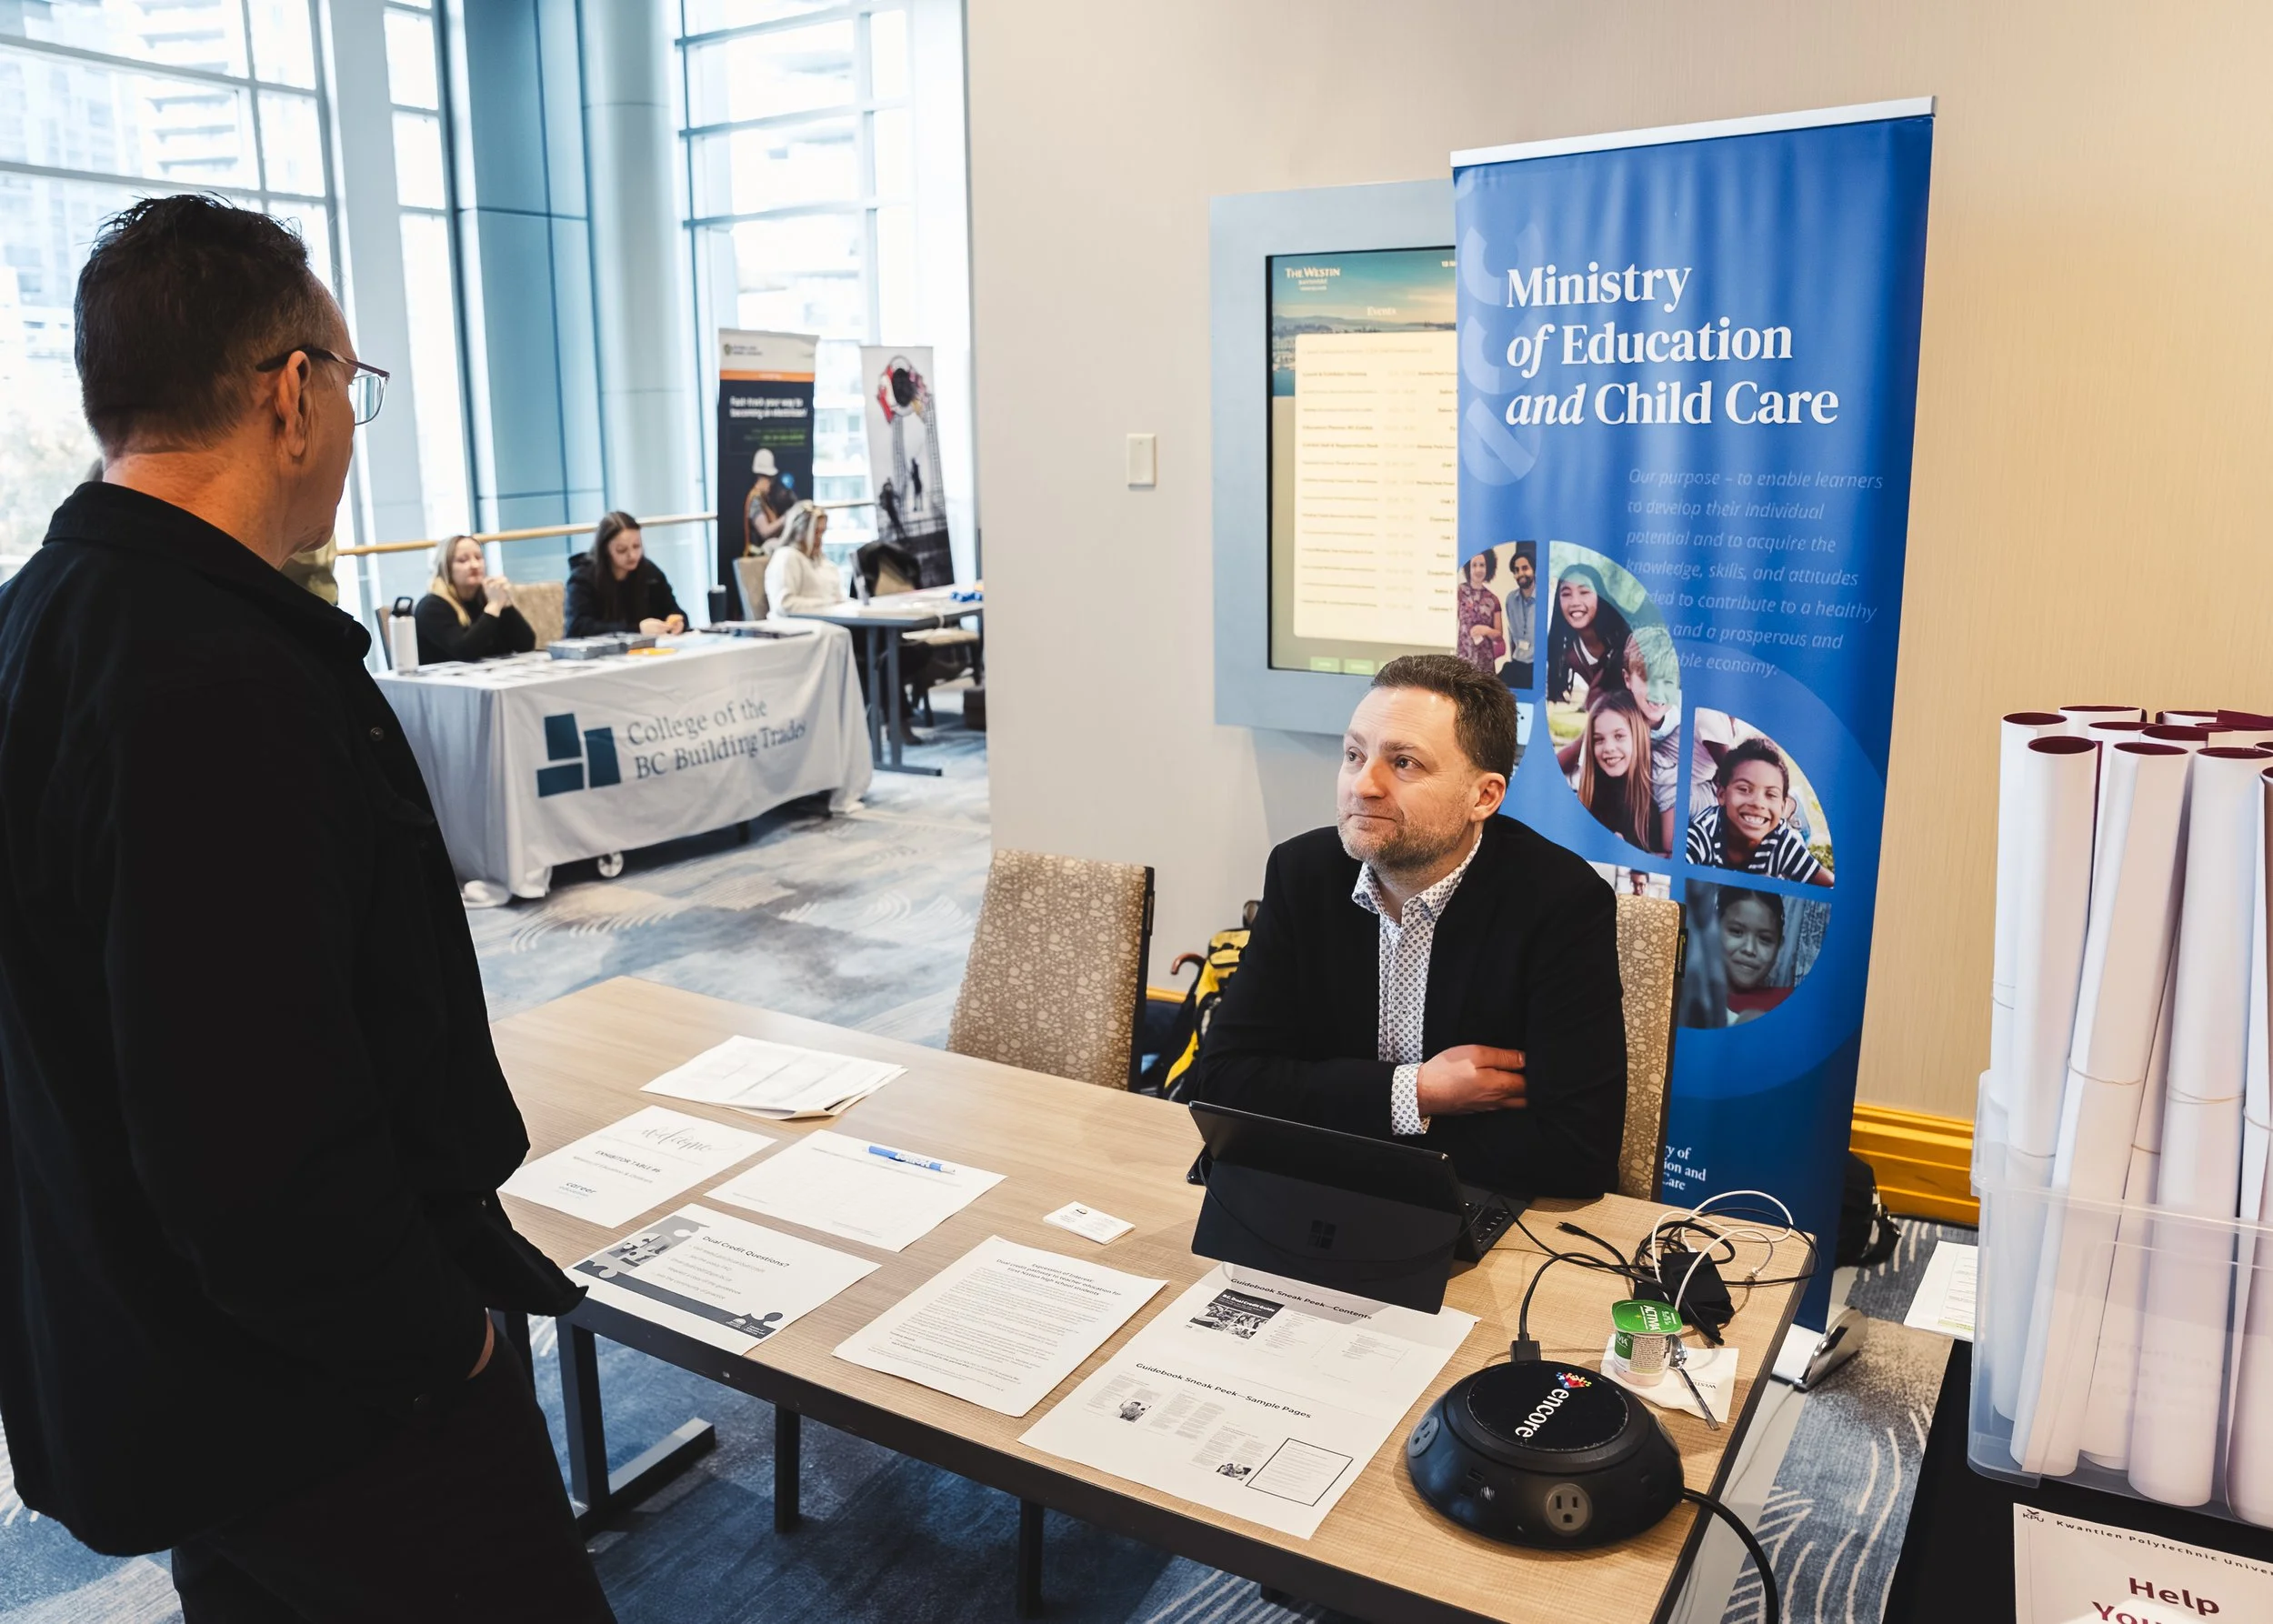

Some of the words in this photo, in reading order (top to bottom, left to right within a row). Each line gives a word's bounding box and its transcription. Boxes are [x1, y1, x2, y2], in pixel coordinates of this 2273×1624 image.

[1304, 266, 1341, 277] WESTIN
[1507, 262, 1691, 313] Ministry
[1507, 324, 1554, 378] of
[1562, 317, 1793, 365] Education
[1506, 384, 1587, 425] and
[1595, 381, 1712, 424] Child
[1725, 382, 1839, 424] Care
[1629, 468, 1657, 484] Our
[1657, 471, 1719, 488] purpose
[1737, 473, 1752, 486] to
[1757, 470, 1811, 487] enable
[1816, 471, 1883, 489] learners
[1627, 500, 1642, 514] to
[1647, 500, 1700, 519] develop
[1706, 500, 1739, 516] their
[1745, 502, 1825, 520] individual
[1626, 530, 1690, 546] potential
[1693, 532, 1725, 546] and
[1728, 534, 1743, 547] to
[1747, 536, 1805, 554] acquire
[1810, 536, 1837, 554] the
[1626, 559, 1703, 580] knowledge,
[1708, 563, 1747, 582] skills,
[1753, 566, 1784, 582] and
[1788, 568, 1858, 586] attitudes
[1678, 593, 1693, 606] to
[1697, 596, 1777, 613] contribute
[1781, 600, 1797, 615] to
[1800, 604, 1811, 616] a
[1817, 603, 1877, 624] healthy
[1673, 623, 1702, 638] and
[1707, 626, 1717, 638] a
[1719, 627, 1807, 647] prosperous
[1811, 634, 1843, 649] and
[1706, 656, 1777, 677] economy.
[627, 715, 708, 746] College
[714, 701, 737, 727] of
[740, 697, 767, 718] the
[635, 751, 669, 779] BC
[676, 731, 758, 771] Building
[760, 718, 806, 748] Trades
[632, 1160, 651, 1171] TABLE
[1677, 1147, 1692, 1160] of
[1664, 1158, 1682, 1174] ion
[1685, 1168, 1707, 1182] and
[566, 1182, 596, 1195] career
[702, 1235, 720, 1245] Dual
[721, 1241, 745, 1253] Credit
[746, 1250, 790, 1268] Questions?
[1011, 1262, 1026, 1270] credit
[1027, 1267, 1052, 1278] pathway
[1059, 1276, 1082, 1285] teacher
[1082, 1282, 1111, 1293] education
[1032, 1263, 1062, 1275] Expression
[1055, 1279, 1074, 1288] school
[1074, 1285, 1099, 1296] students
[1230, 1278, 1275, 1294] Guidebook
[1277, 1289, 1303, 1302] Sneak
[1243, 1299, 1260, 1309] Credit
[1259, 1304, 1276, 1312] Guide
[1136, 1363, 1184, 1380] Guidebook
[1185, 1377, 1213, 1390] Sneak
[1281, 1406, 1311, 1419] Pages
[1693, 1381, 1717, 1389] WESTI
[1515, 1387, 1569, 1439] encore
[2022, 1511, 2045, 1524] KPU
[2057, 1519, 2122, 1539] Kwantlen
[2129, 1535, 2218, 1562] Polytechnic
[2128, 1577, 2220, 1617] Help
